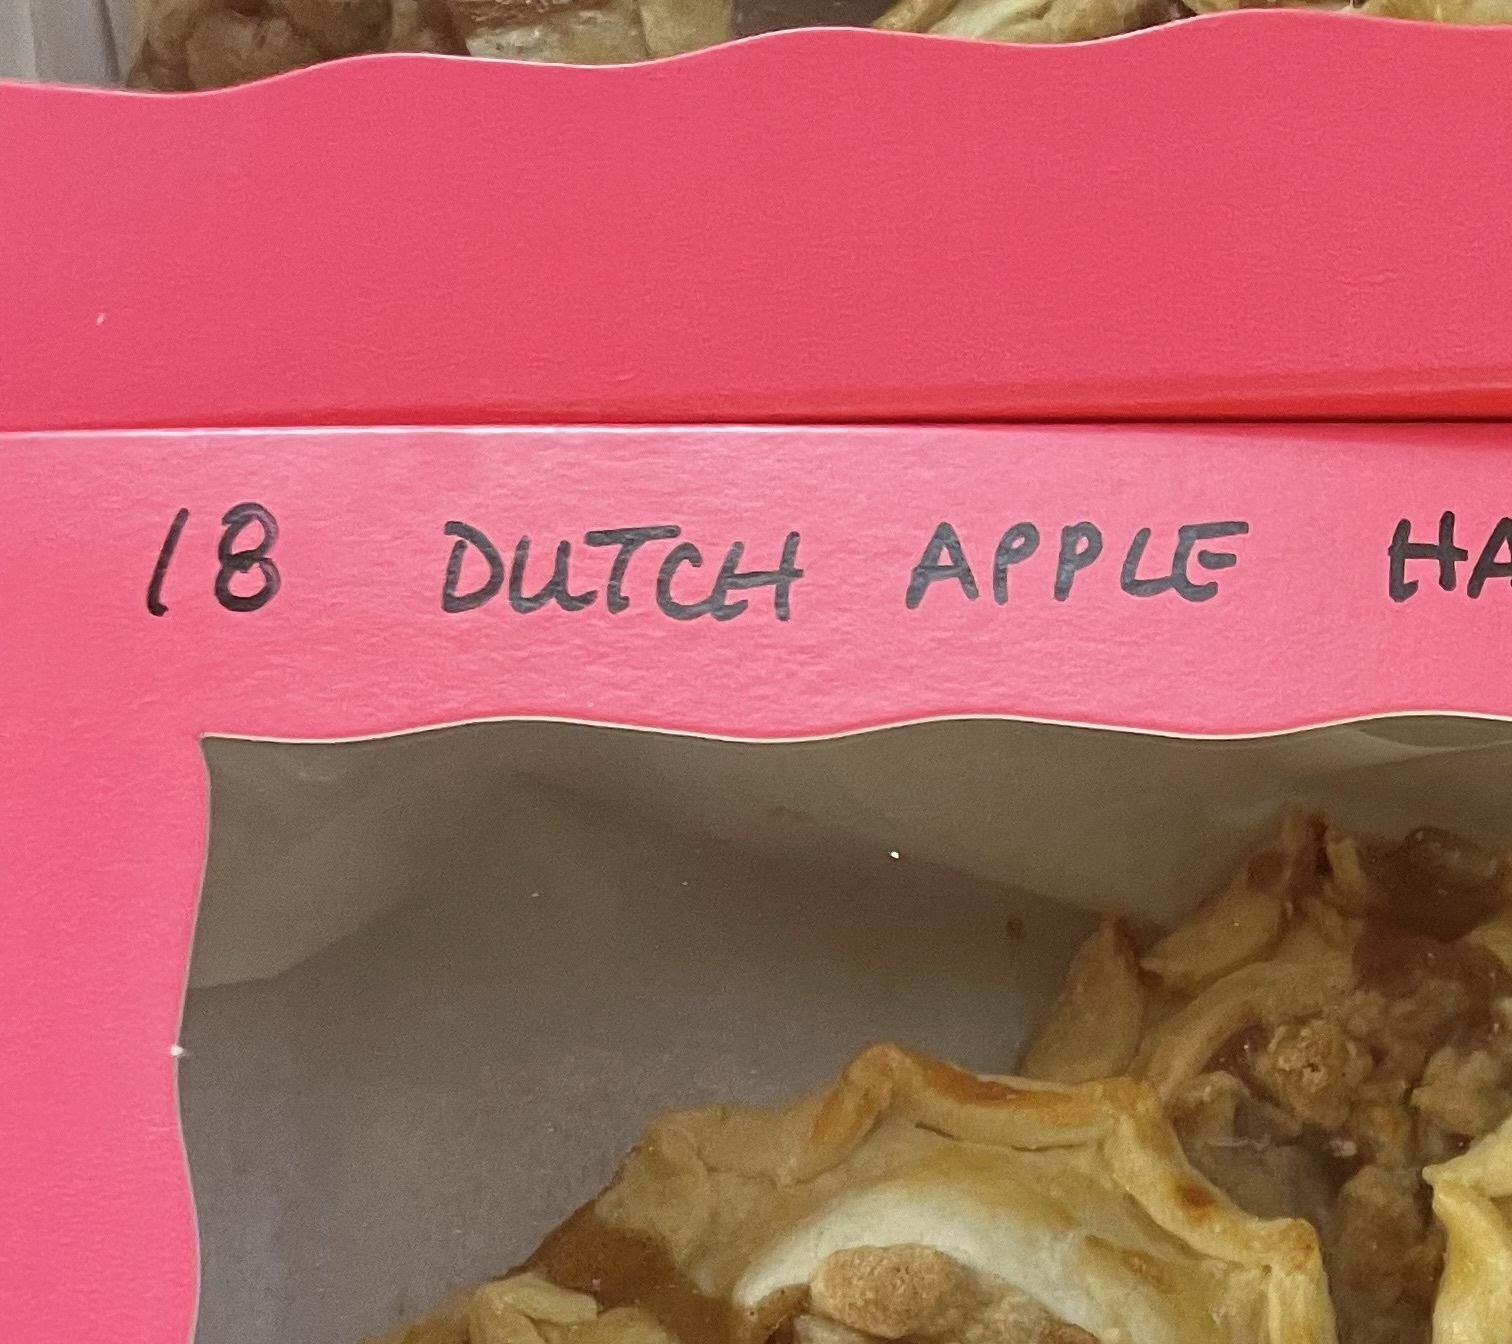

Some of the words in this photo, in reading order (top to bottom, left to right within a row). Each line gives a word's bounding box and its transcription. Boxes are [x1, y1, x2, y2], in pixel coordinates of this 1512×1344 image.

[146, 502, 282, 617] 18
[441, 519, 804, 622] DUTCH
[905, 520, 1251, 609] APPLE
